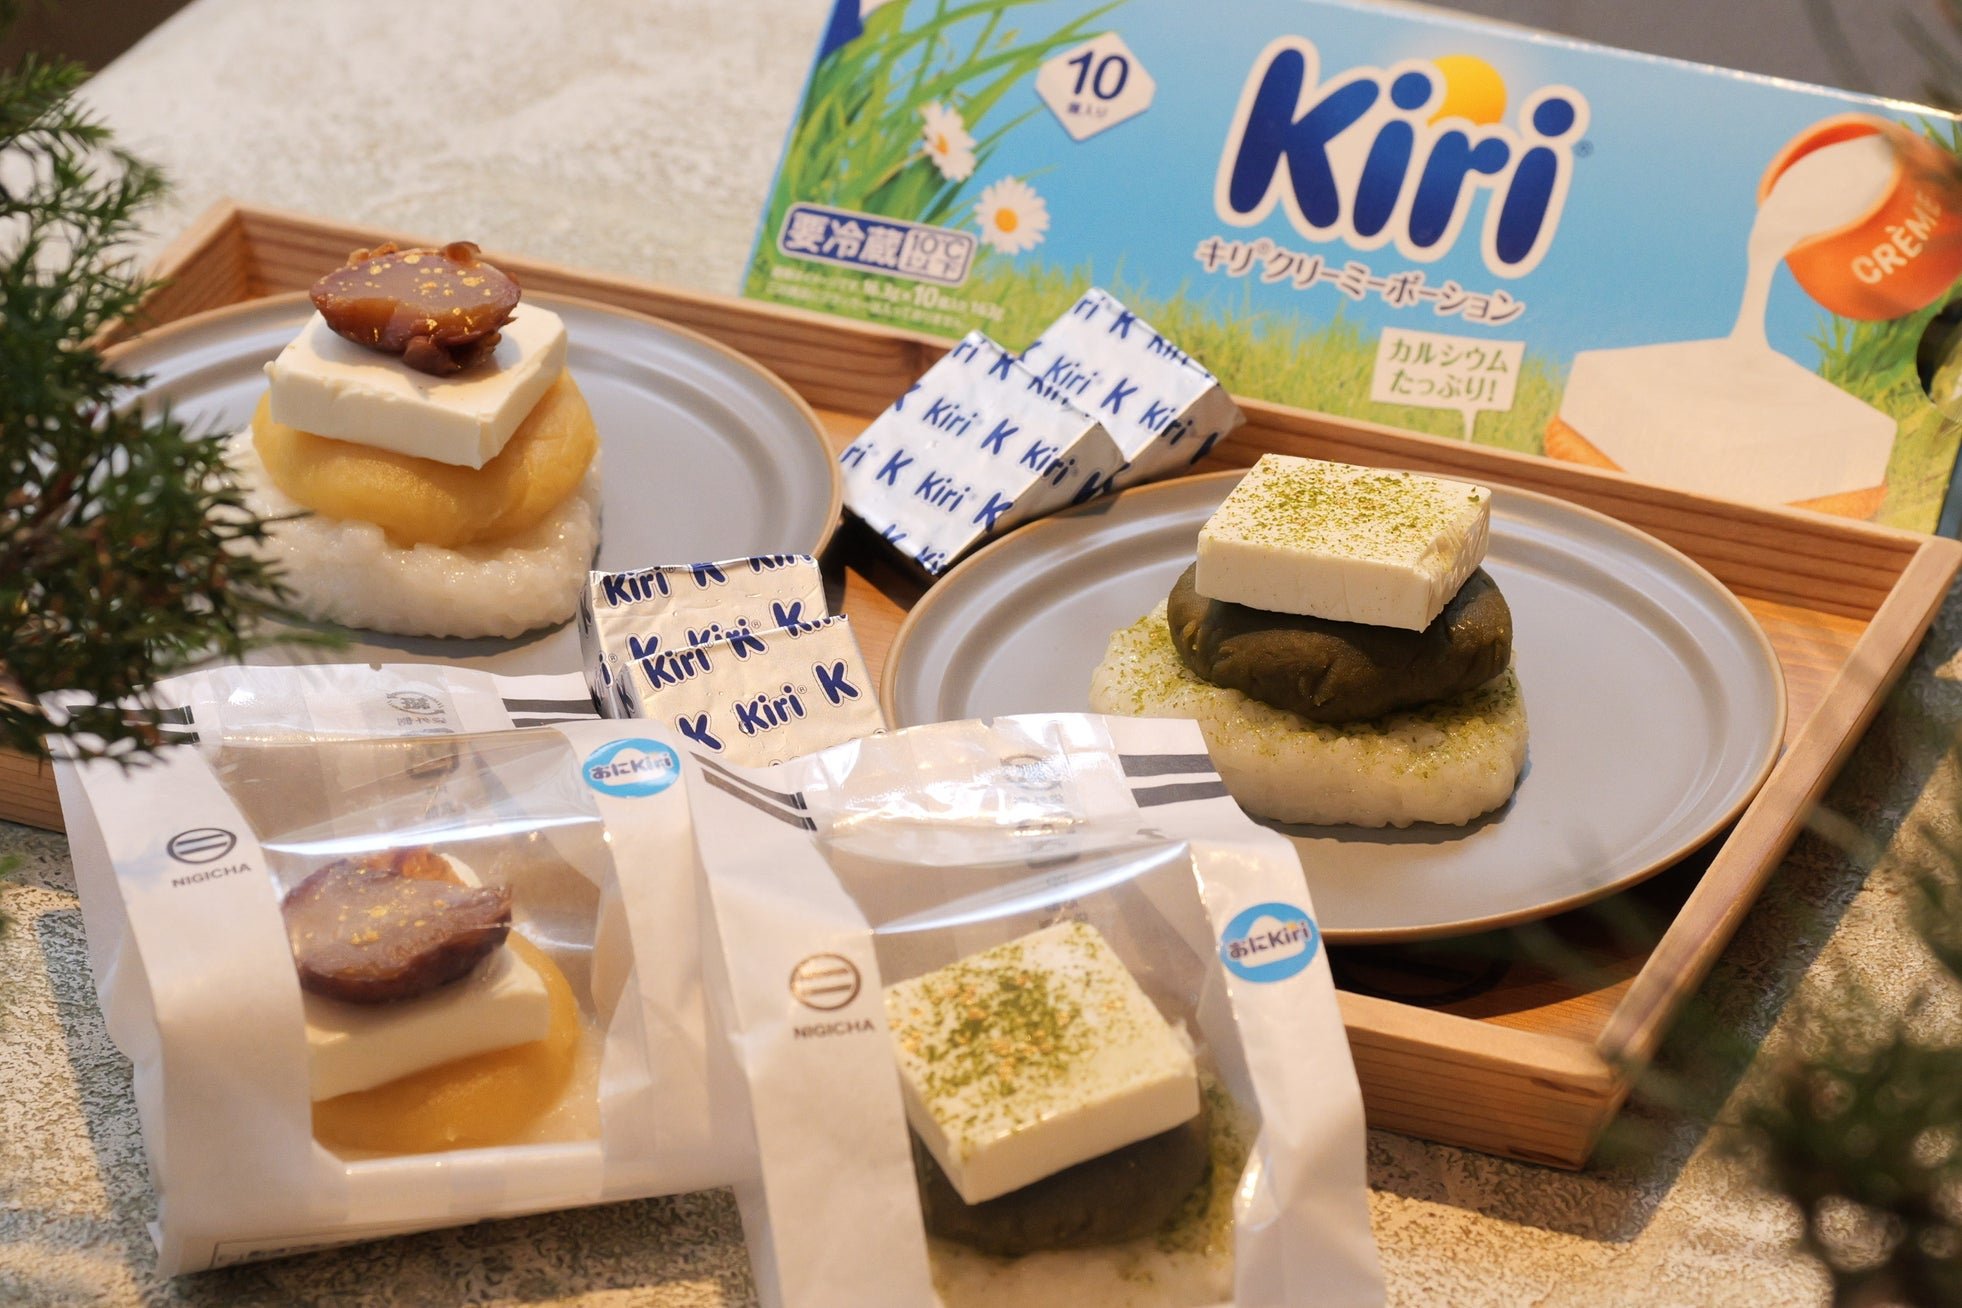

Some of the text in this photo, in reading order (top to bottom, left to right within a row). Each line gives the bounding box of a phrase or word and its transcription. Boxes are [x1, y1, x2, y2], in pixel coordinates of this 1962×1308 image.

[1068, 51, 1129, 100] 10
[1229, 48, 1575, 265] Kiri
[786, 211, 905, 269] 要冷蔵
[1388, 337, 1509, 373] カルシウム
[1043, 355, 1099, 395] Kiri
[1100, 377, 1139, 415] K
[1389, 368, 1497, 402] たっぷり!
[922, 397, 978, 437] Kiri
[980, 417, 1019, 456] K
[1019, 440, 1076, 486] Kiri
[875, 449, 914, 486] K
[914, 471, 971, 513] Kiri
[972, 492, 1014, 533] K
[602, 566, 669, 606] Kiri
[642, 648, 711, 689] Kiri
[678, 661, 859, 751] K Kiri K
[171, 863, 252, 888] NIGICHA
[1229, 921, 1309, 959] おにKiri
[793, 1019, 876, 1039] NIGICHA
